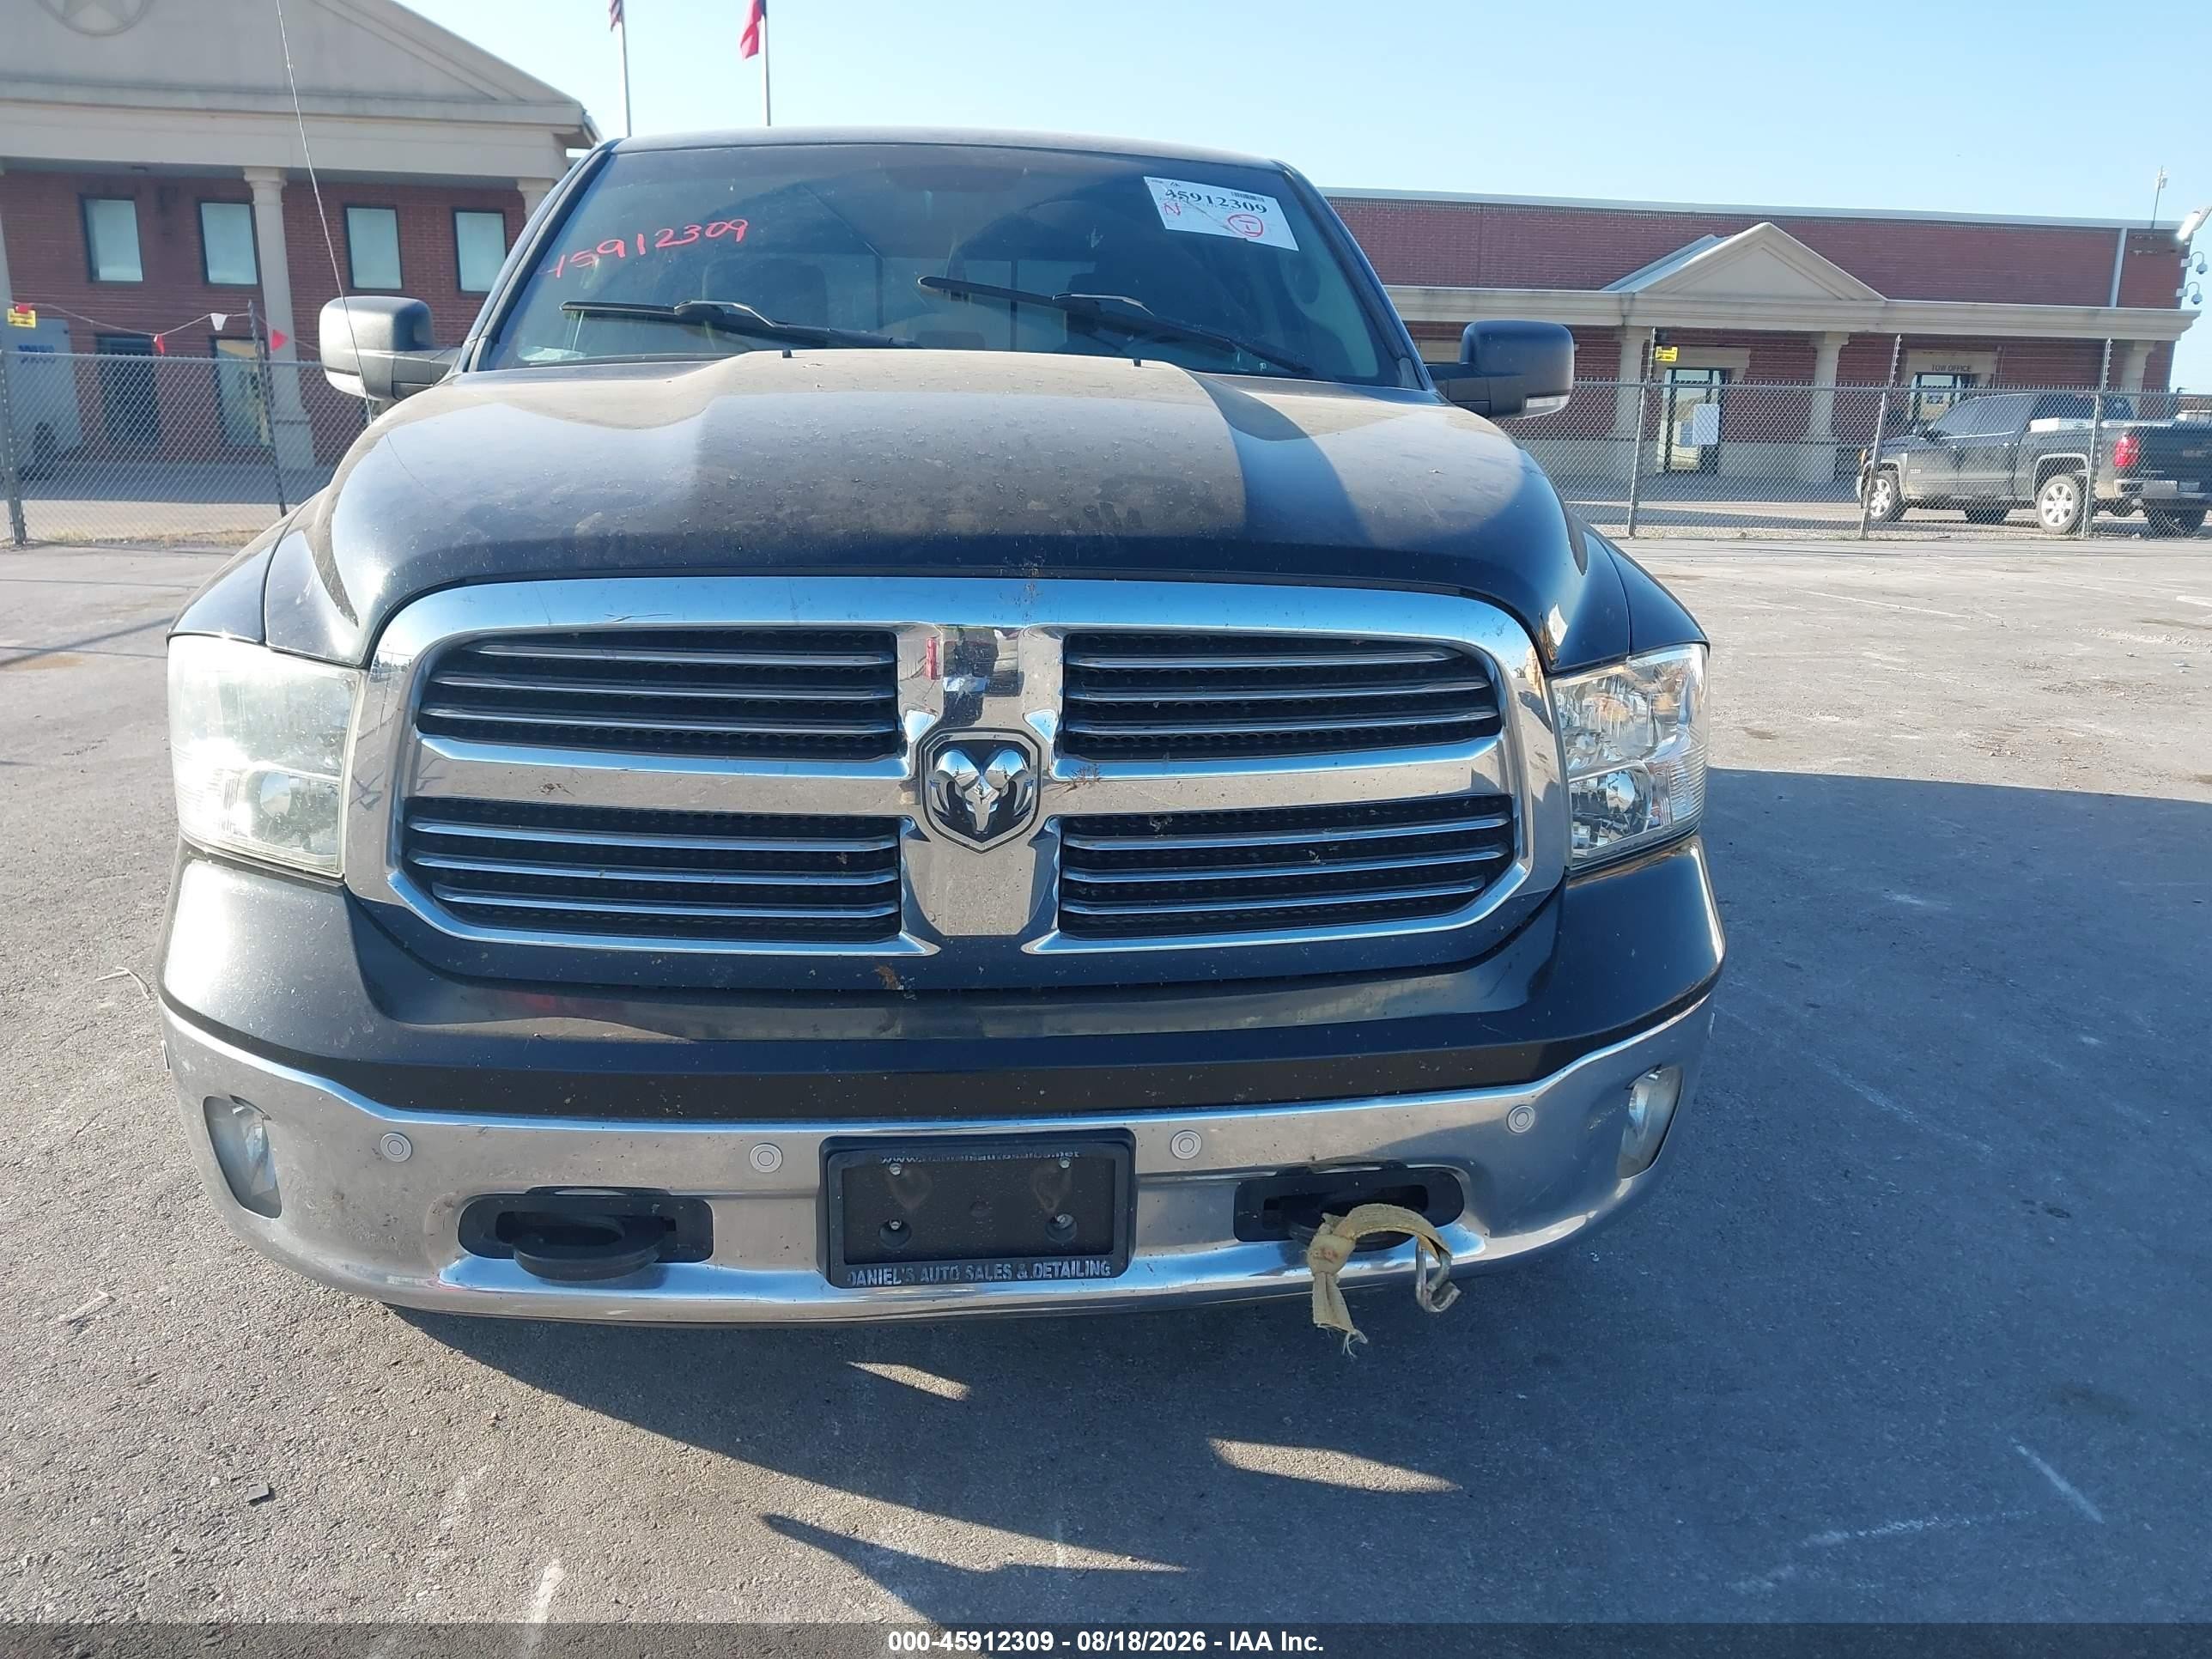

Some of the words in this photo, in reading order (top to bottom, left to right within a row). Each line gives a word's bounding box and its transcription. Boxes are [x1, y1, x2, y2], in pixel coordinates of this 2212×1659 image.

[1166, 188, 1267, 213] 45912309
[1931, 363, 1946, 372] TOW
[1948, 363, 1972, 373] OFFICE
[921, 1264, 961, 1284] AUTO
[965, 1262, 1013, 1281] SALES
[1017, 1263, 1029, 1280] &
[1033, 1260, 1112, 1279] DETAILING
